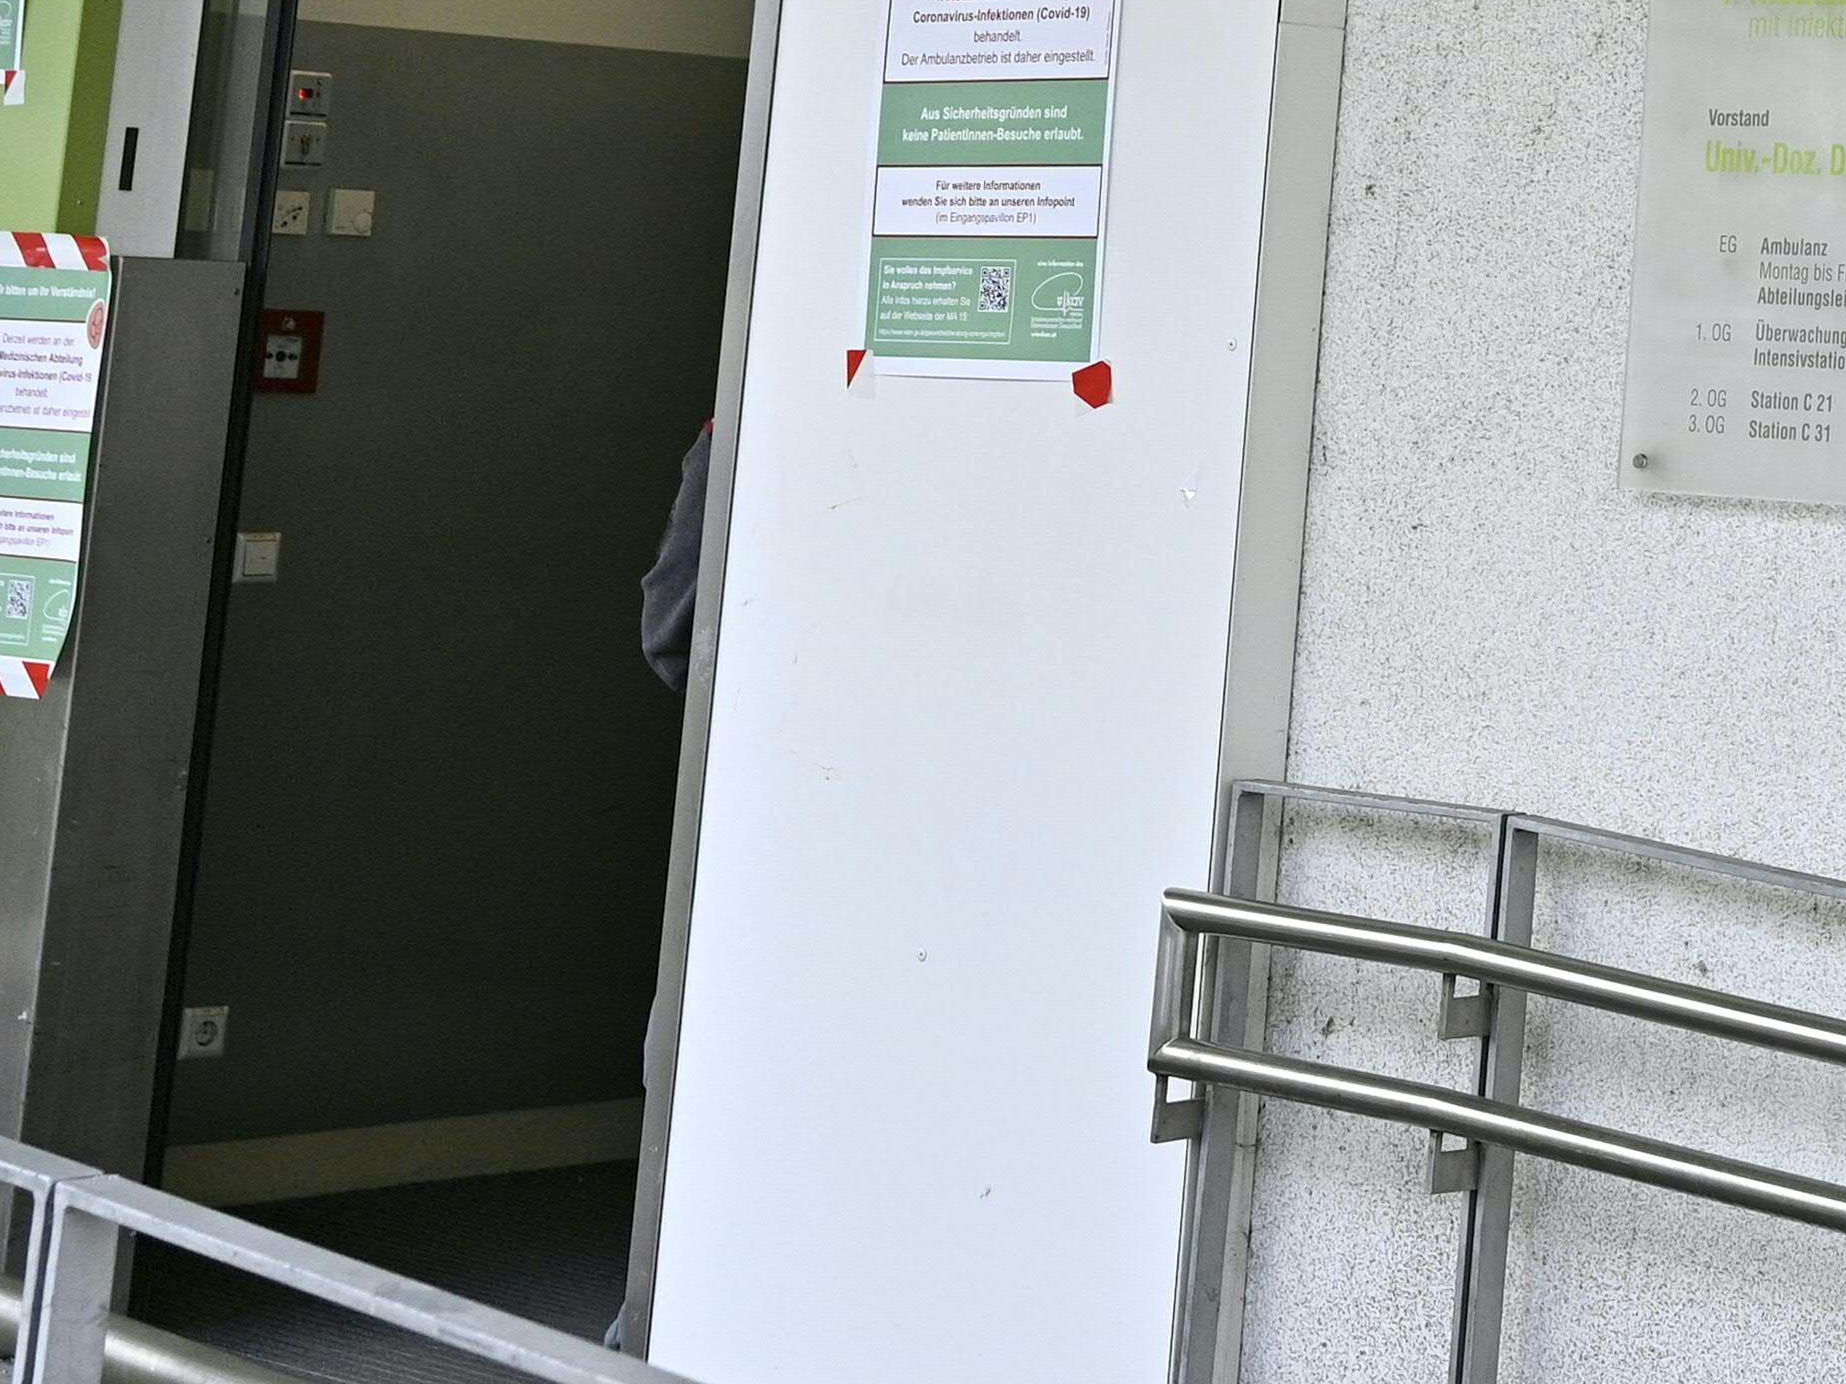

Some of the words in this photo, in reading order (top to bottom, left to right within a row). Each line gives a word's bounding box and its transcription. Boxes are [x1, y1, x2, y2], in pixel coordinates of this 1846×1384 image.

[913, 8, 1033, 23] Coronavirus-Infektionen
[1037, 6, 1090, 22] (Covid-19)
[902, 54, 918, 65] Der
[920, 52, 998, 65] Ambulanzbetrieb
[1001, 53, 1011, 63] ist
[1014, 52, 1041, 63] daher
[1044, 49, 1095, 65] eingestellt.
[920, 108, 940, 120] Aus
[943, 106, 1042, 121] Sicherheitsgründen
[1044, 106, 1067, 118] sind
[1709, 108, 1769, 127] Vorstand
[903, 129, 928, 141] keine
[1044, 127, 1083, 139] erlaubt.
[1705, 140, 1821, 175] Univ.-Doz.
[936, 180, 950, 190] Für
[952, 181, 981, 190] weitere
[984, 180, 1040, 190] Informationen
[902, 197, 932, 206] wenden
[935, 197, 947, 206] Sie
[950, 197, 966, 206] sich
[969, 197, 986, 206] bitte
[1002, 198, 1034, 206] unseren
[1037, 197, 1075, 208] Infopoint
[1719, 235, 1737, 252] EG
[1761, 237, 1828, 256] Ambulanz
[1759, 262, 1808, 285] Montag
[1814, 263, 1833, 282] bis
[1696, 323, 1706, 341] 1.
[1712, 323, 1731, 341] OG
[1691, 388, 1702, 406] 2.
[1707, 389, 1727, 407] OG
[1751, 391, 1799, 411] Station
[1803, 393, 1812, 411] C
[1817, 394, 1832, 412] 21
[1688, 415, 1700, 432] 3.
[1705, 415, 1725, 434] OG
[1749, 421, 1797, 441] Station
[1801, 423, 1810, 441] C
[1815, 424, 1830, 442] 31
